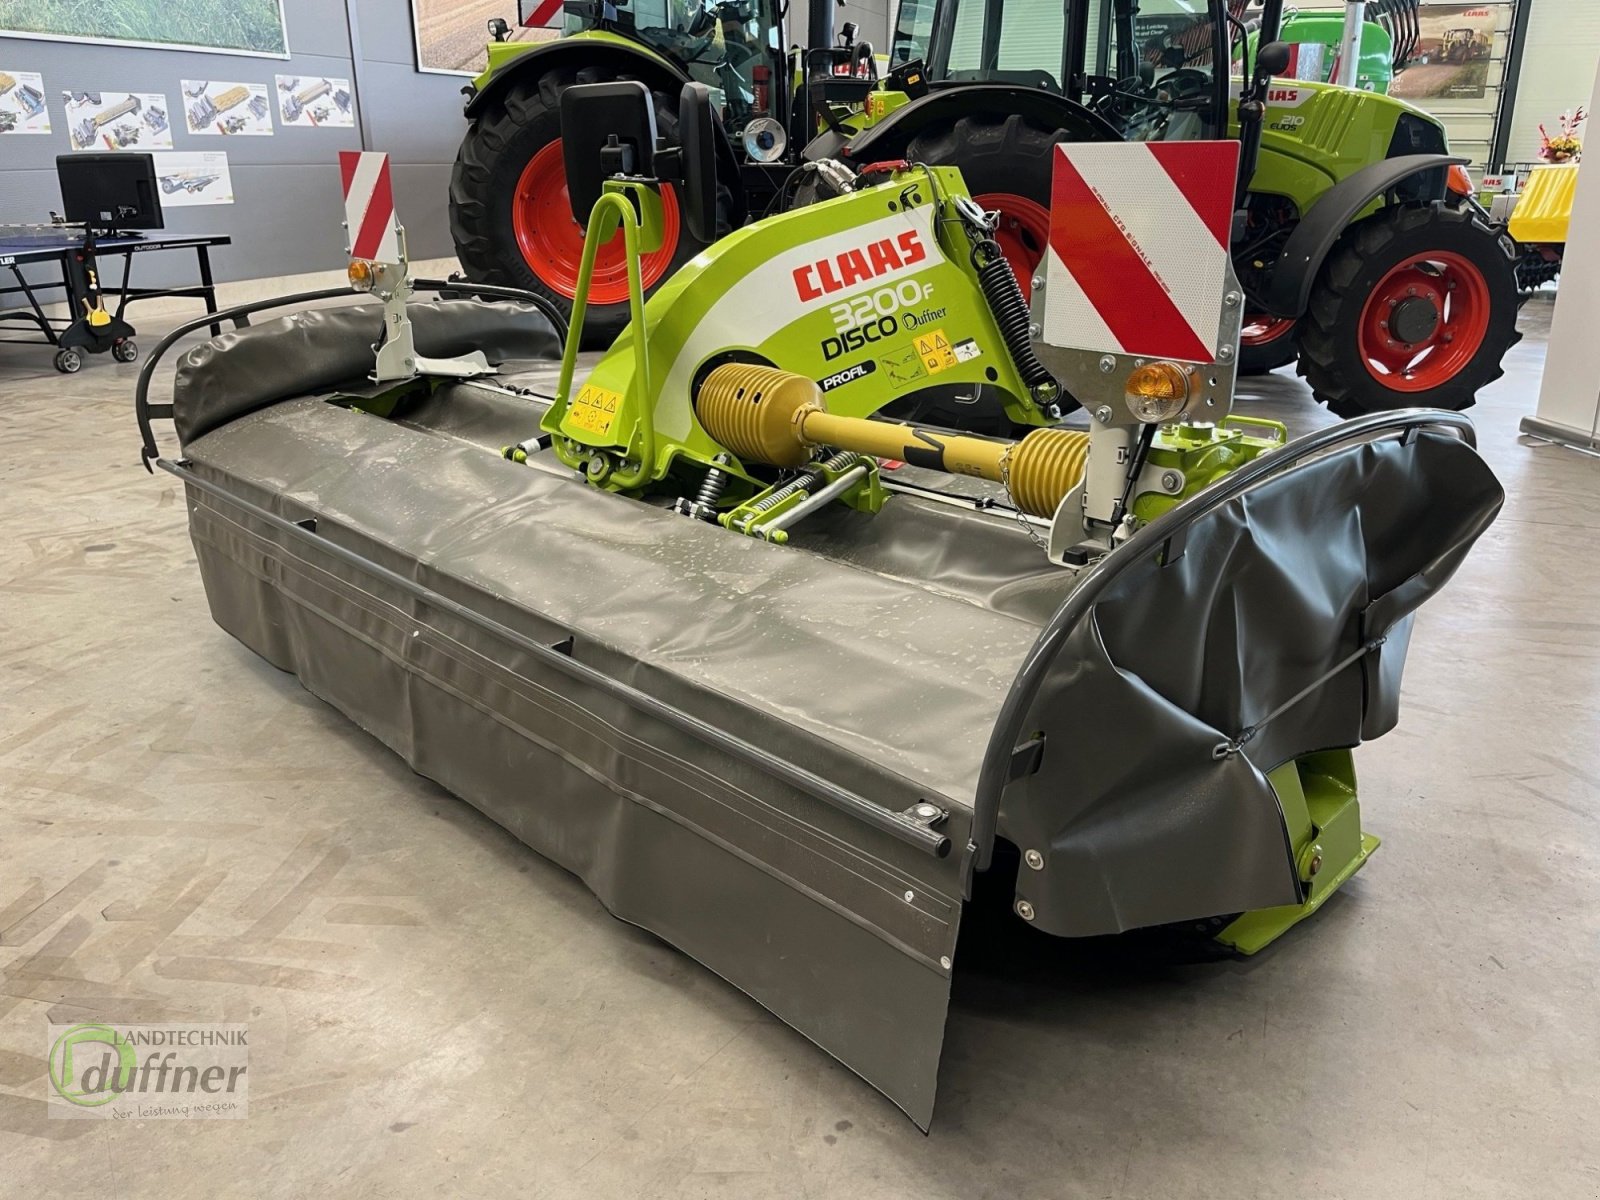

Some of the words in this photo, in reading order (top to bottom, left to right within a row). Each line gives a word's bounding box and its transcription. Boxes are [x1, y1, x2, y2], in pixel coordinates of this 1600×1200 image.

[1281, 115, 1305, 126] 210
[793, 229, 926, 302] CLAAS
[821, 315, 898, 361] DISCO
[823, 364, 868, 391] PROFIL
